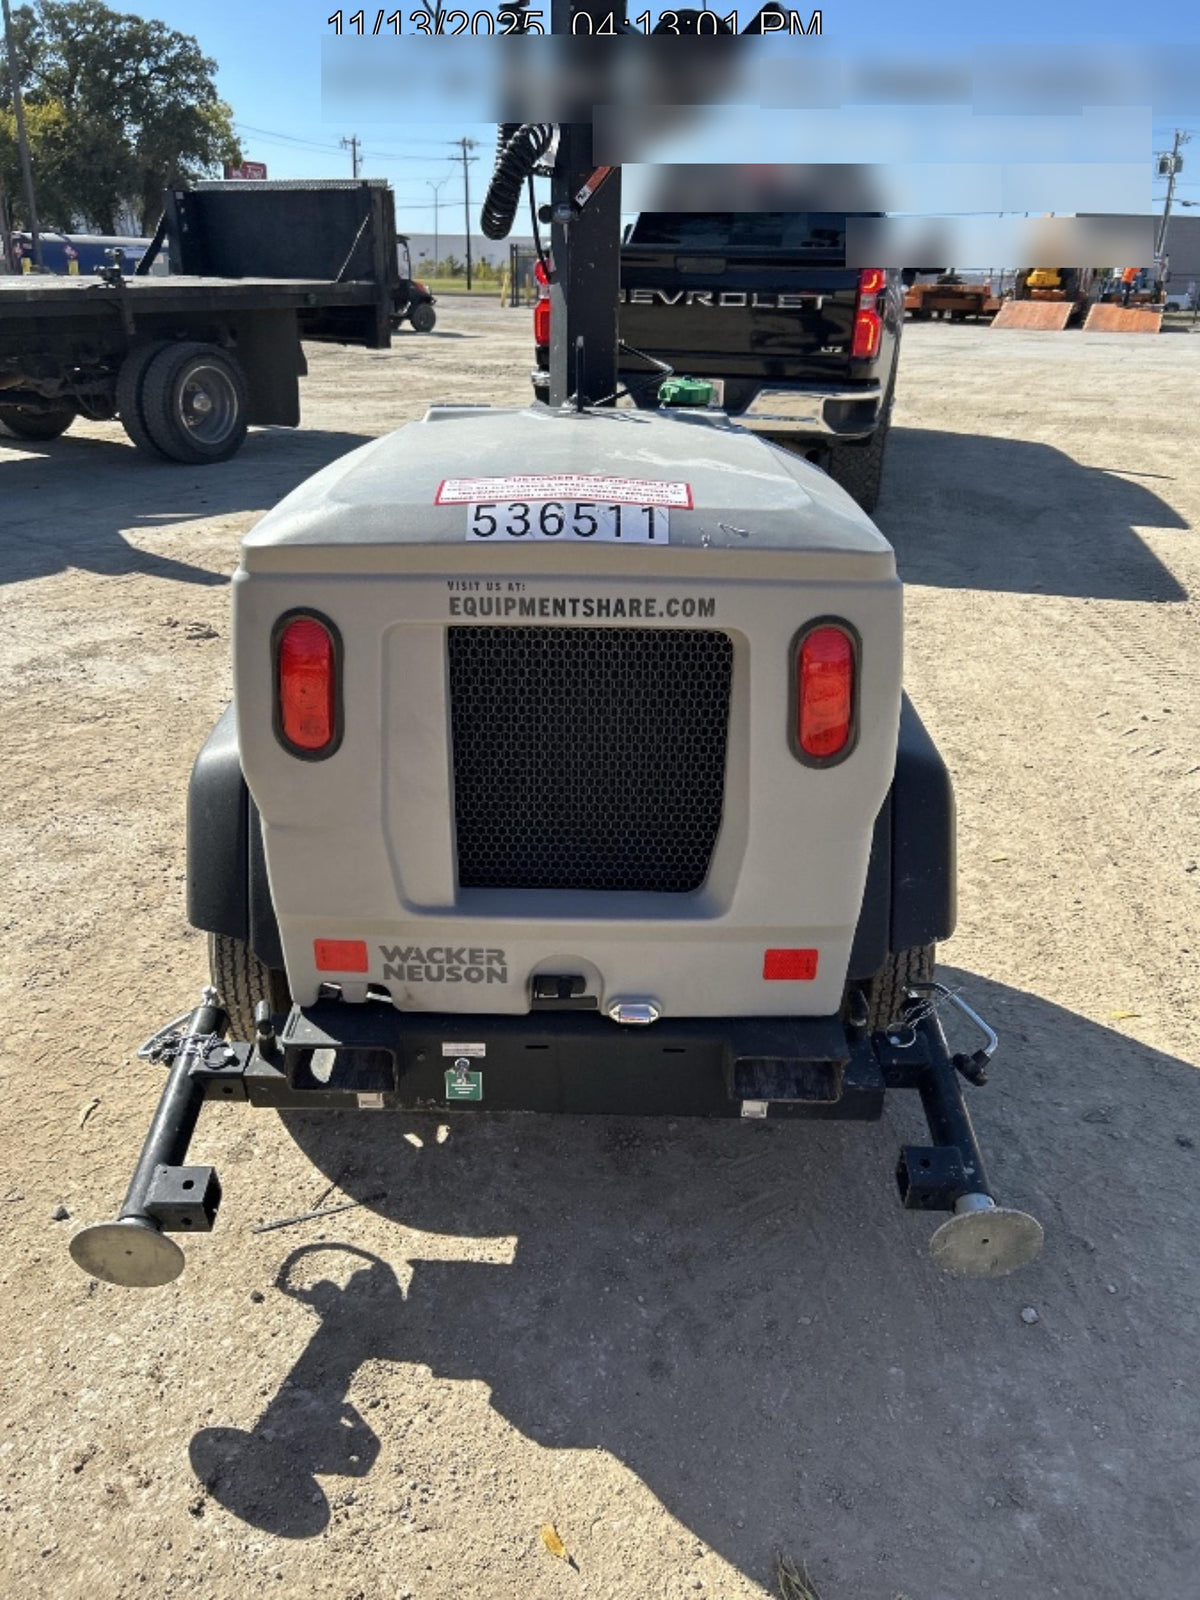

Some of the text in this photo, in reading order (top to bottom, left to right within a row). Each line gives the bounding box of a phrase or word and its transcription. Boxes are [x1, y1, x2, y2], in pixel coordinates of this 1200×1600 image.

[619, 288, 833, 311] EVROLET
[471, 502, 655, 540] 536511
[447, 581, 526, 593] VISIT US AT:
[449, 596, 716, 618] EQUIPMENTSHARE.COM
[378, 945, 508, 966] WACKER
[382, 963, 508, 984] NEUSON
